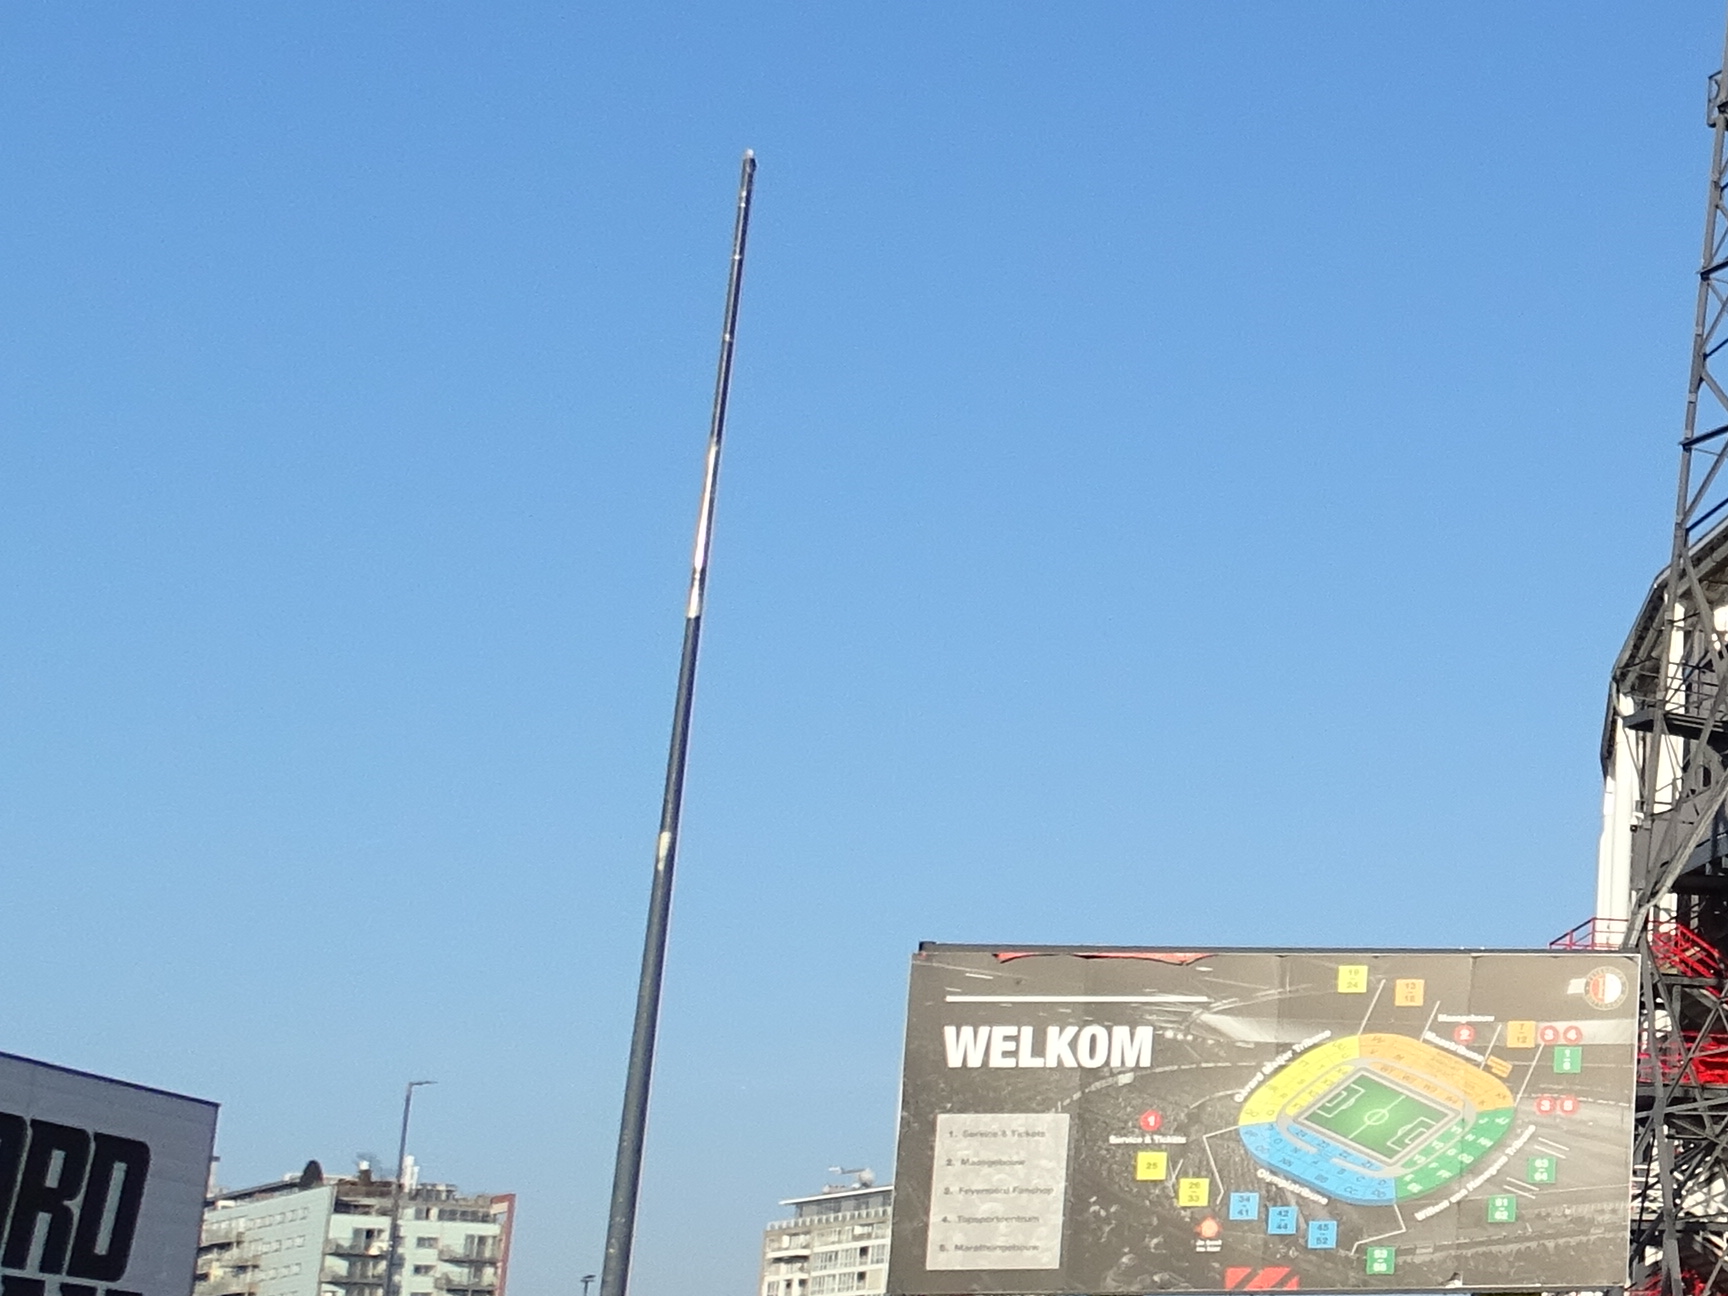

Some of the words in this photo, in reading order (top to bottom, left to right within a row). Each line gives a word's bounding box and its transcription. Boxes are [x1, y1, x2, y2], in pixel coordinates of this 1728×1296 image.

[1566, 1029, 1577, 1040] 4
[944, 1025, 1154, 1068] WELKOM
[1147, 1116, 1156, 1126] 1
[1146, 1162, 1158, 1170] 25
